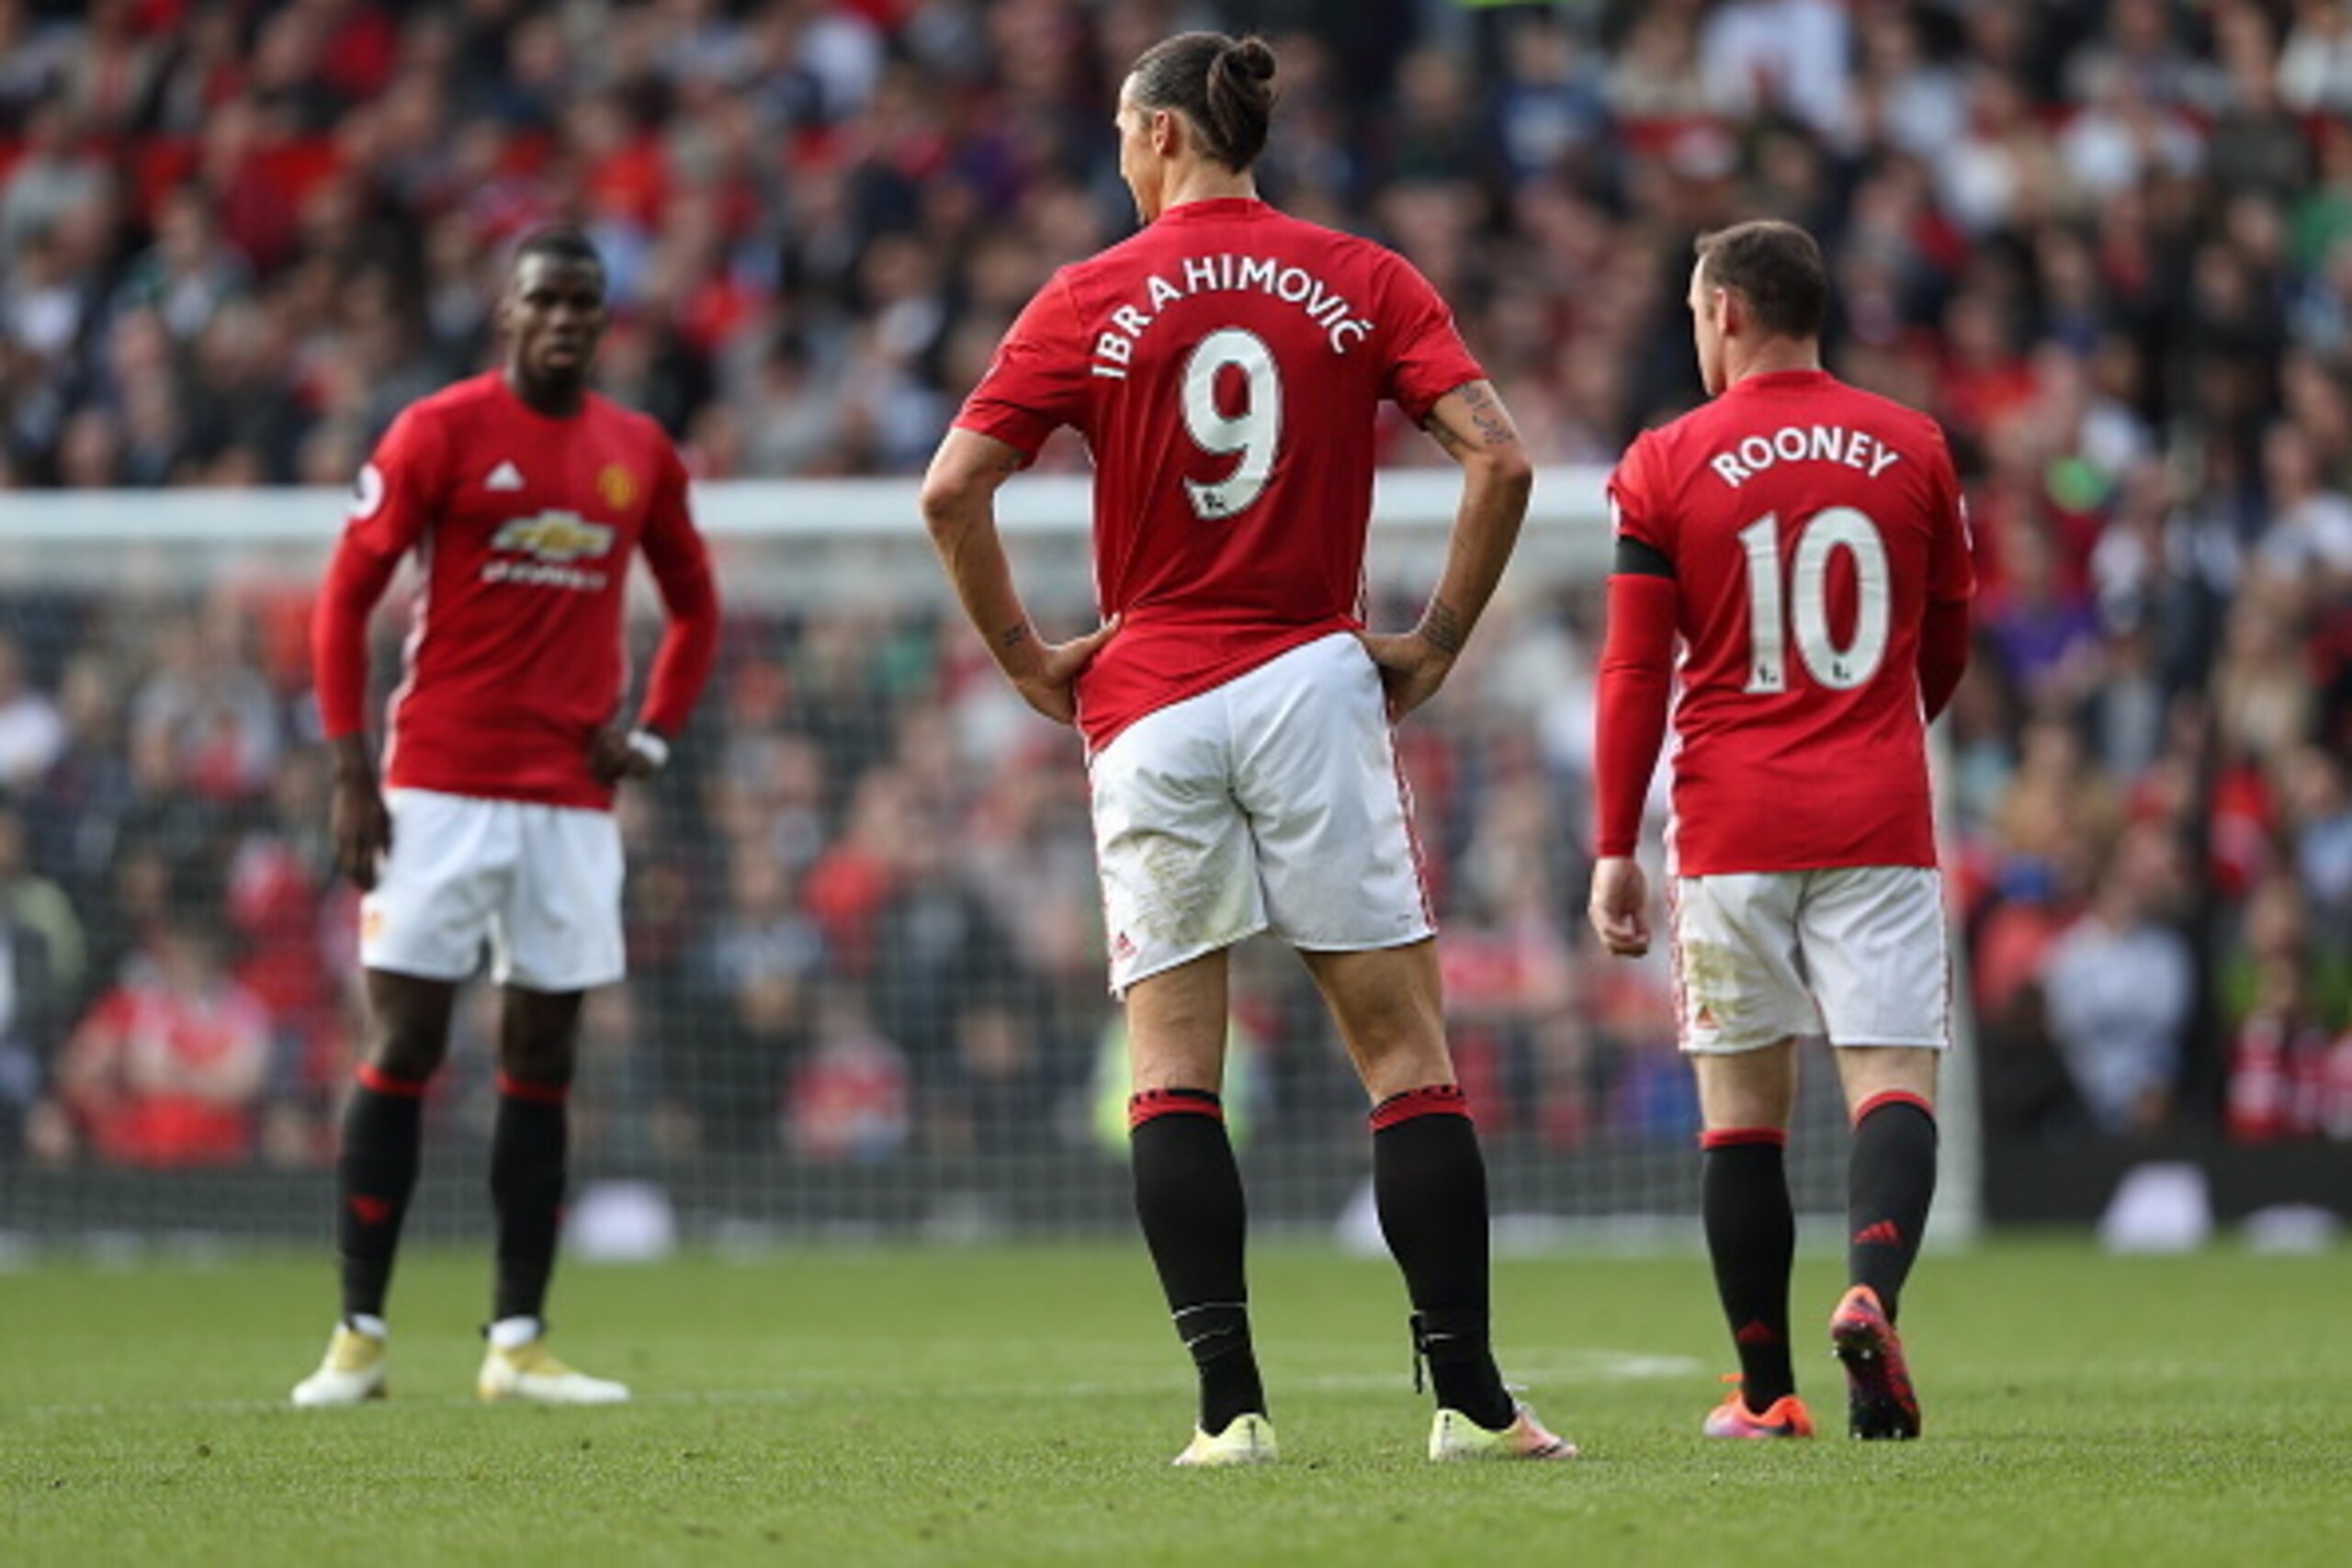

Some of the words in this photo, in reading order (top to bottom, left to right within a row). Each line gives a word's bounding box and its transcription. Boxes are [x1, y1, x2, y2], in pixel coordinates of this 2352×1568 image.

[1091, 254, 1374, 378] IBRAHIMOVIĆ
[1181, 327, 1282, 519] 9
[1710, 424, 1899, 488] ROONEY
[1737, 505, 1890, 694] 10
